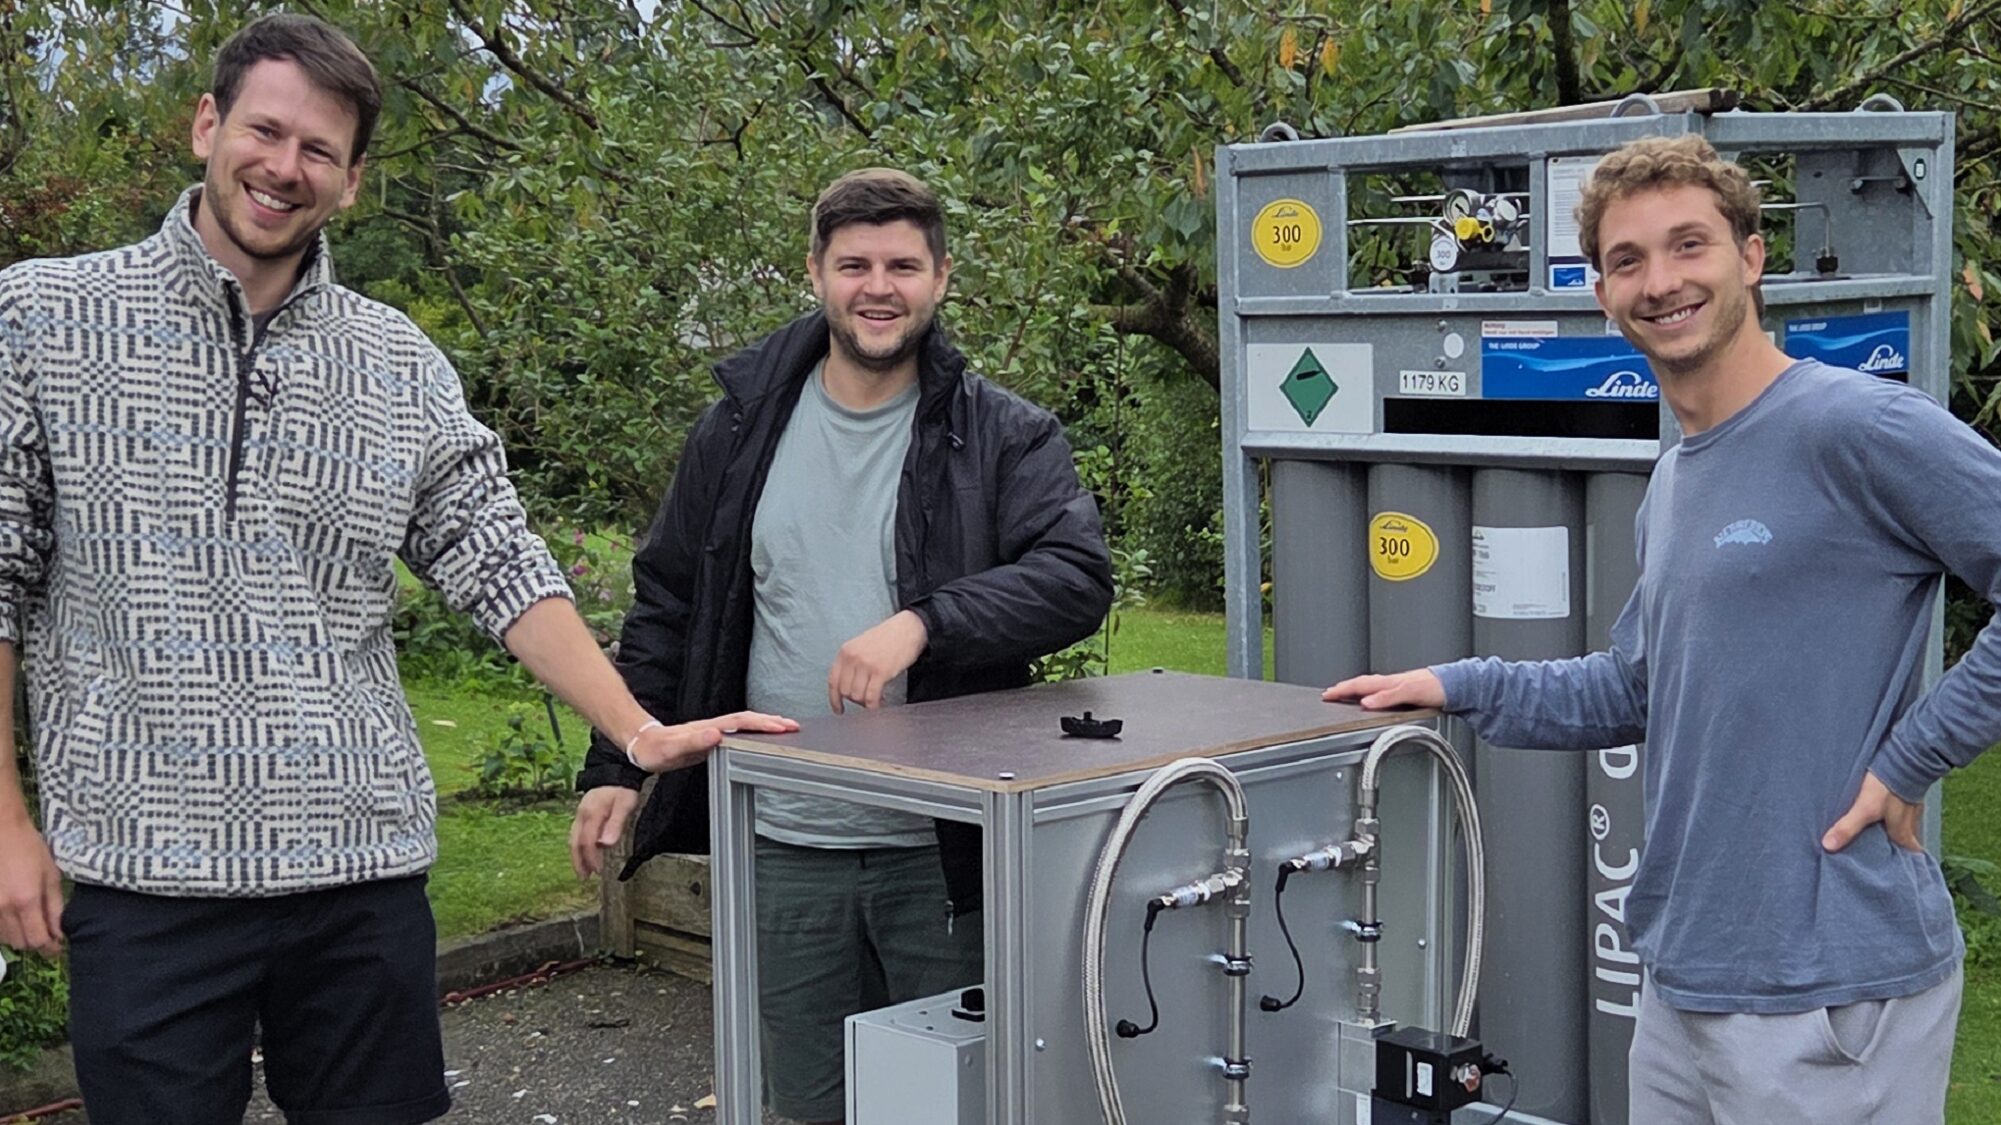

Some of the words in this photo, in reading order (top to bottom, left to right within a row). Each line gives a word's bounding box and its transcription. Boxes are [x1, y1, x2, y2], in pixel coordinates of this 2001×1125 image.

[1273, 224, 1301, 244] 300
[1858, 344, 1904, 371] Linde
[1403, 374, 1434, 391] 1179
[1438, 375, 1459, 392] KG
[1585, 370, 1658, 398] Linde
[1379, 537, 1410, 556] 300
